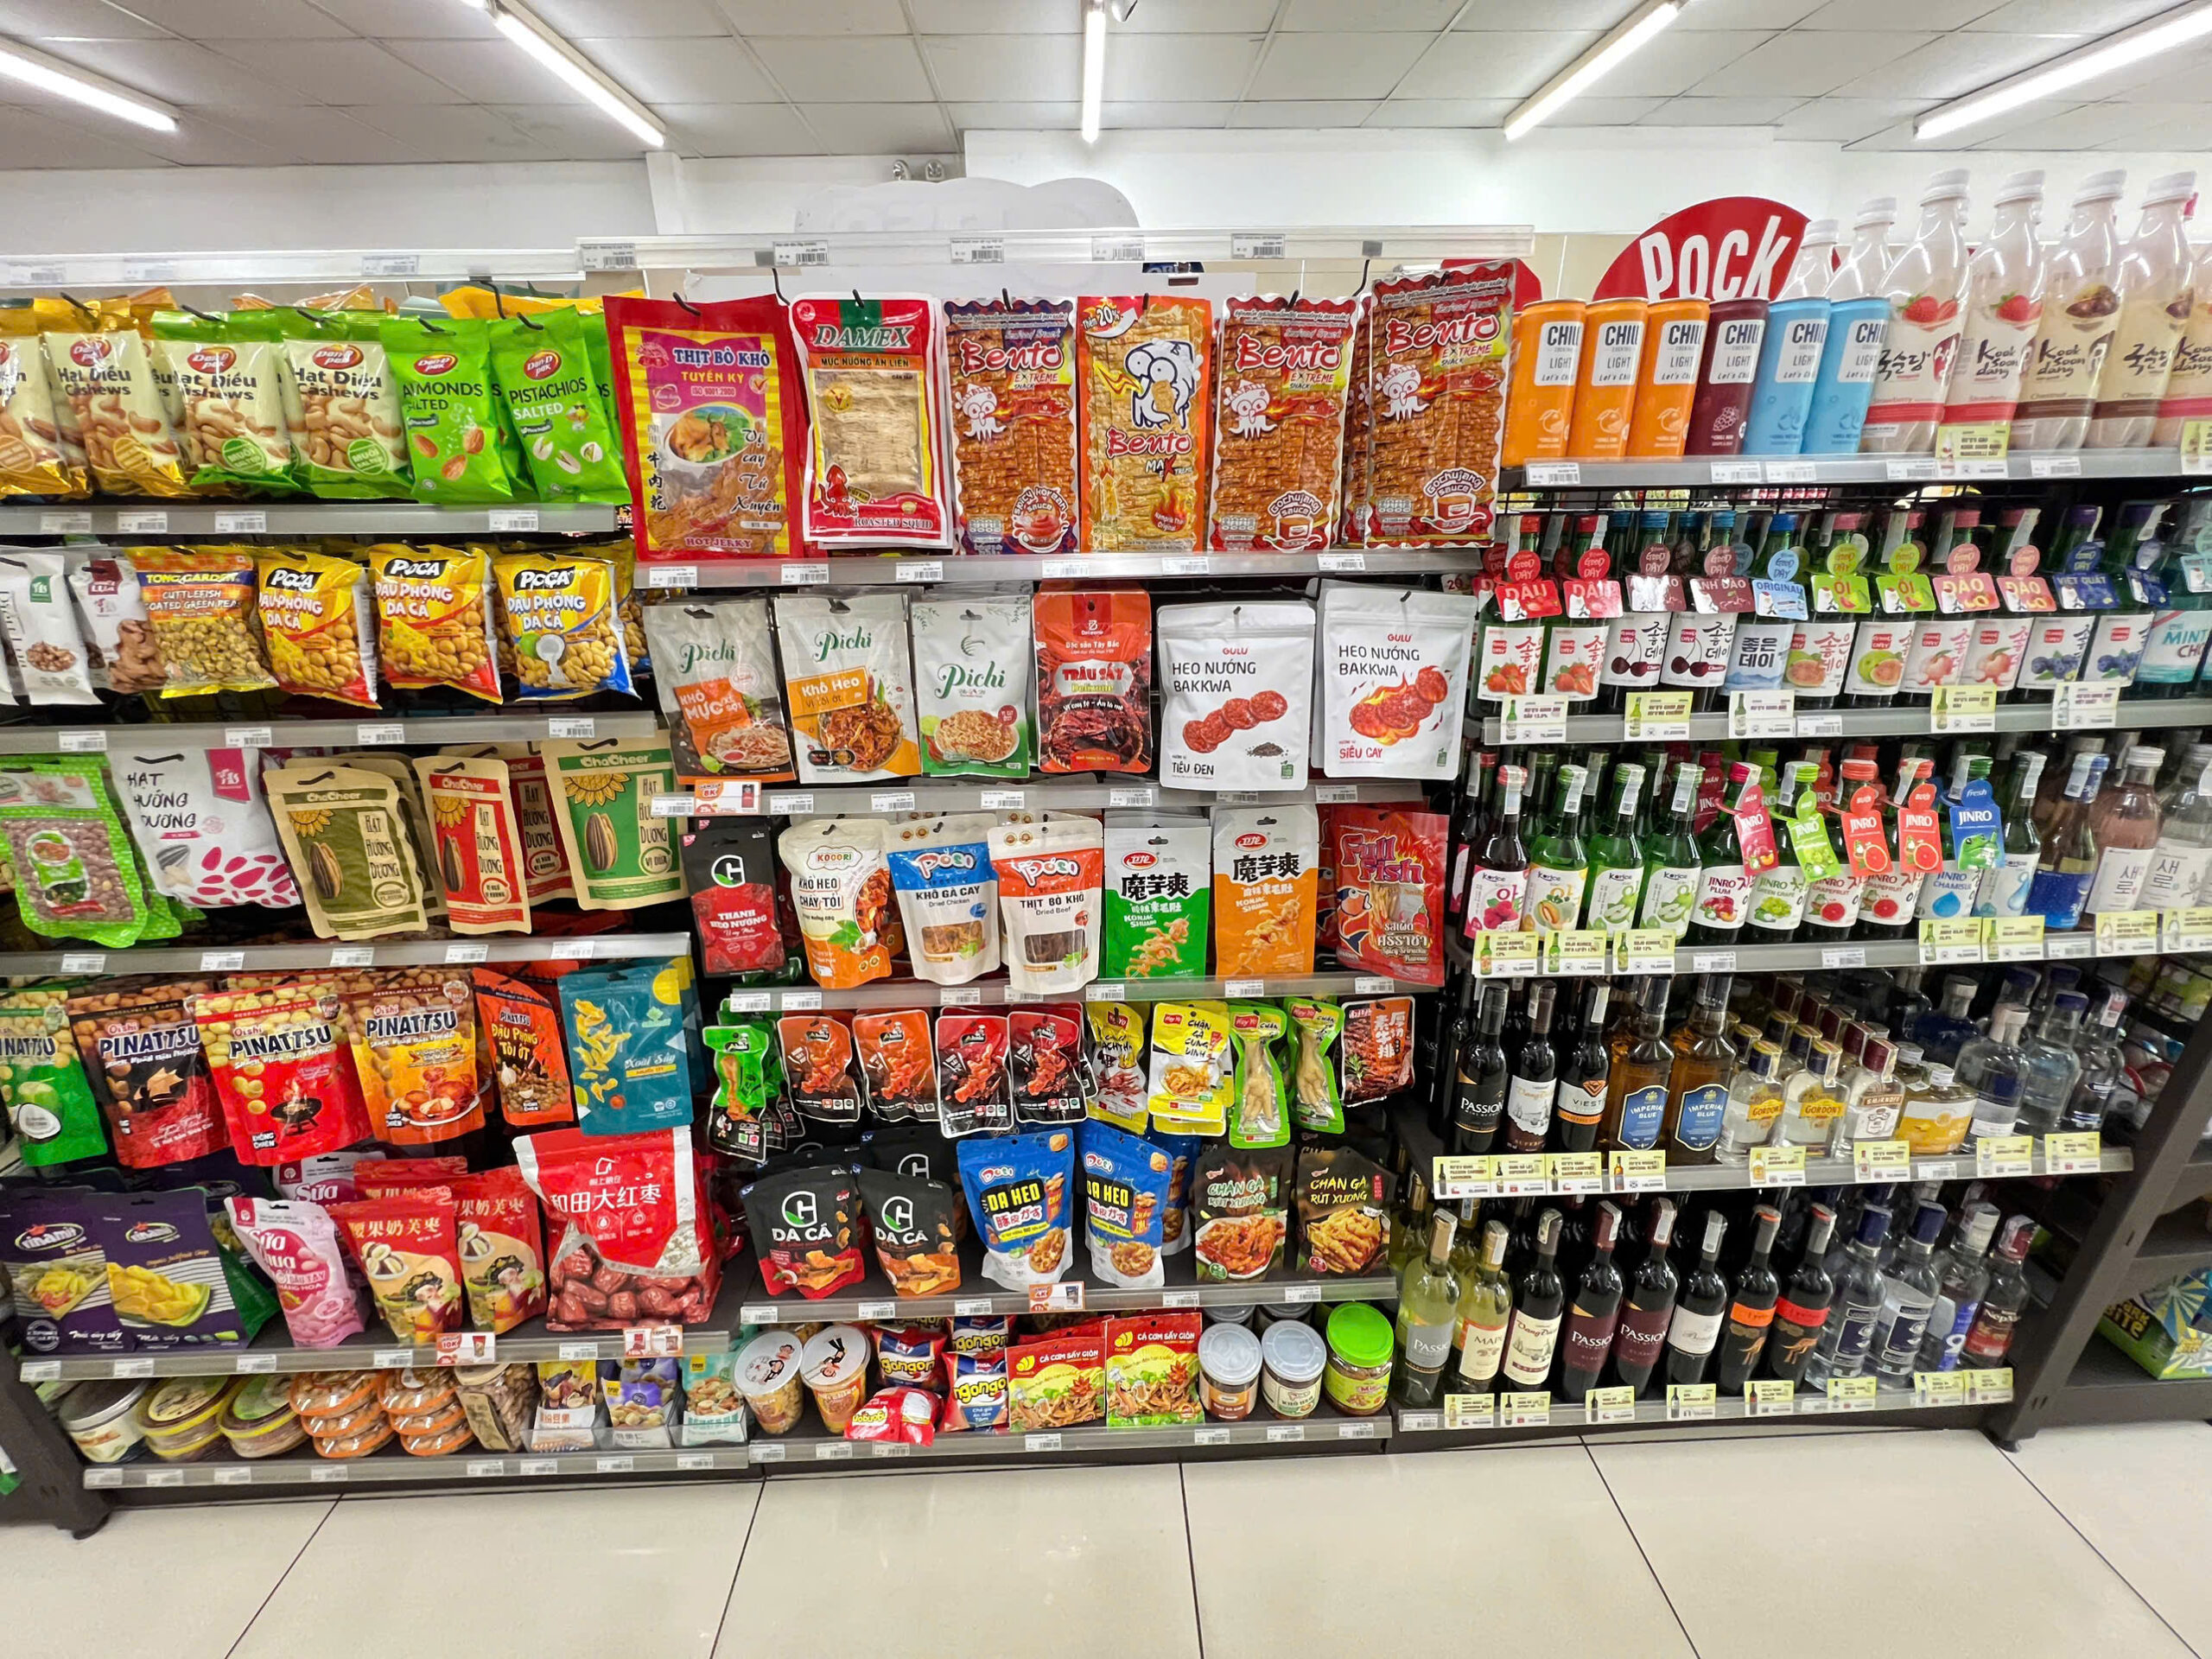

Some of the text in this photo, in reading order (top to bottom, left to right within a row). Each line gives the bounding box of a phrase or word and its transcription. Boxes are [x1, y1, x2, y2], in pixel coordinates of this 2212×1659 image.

[1096, 305, 1122, 327] 20%
[815, 324, 914, 347] DAMEX
[1385, 313, 1501, 357] Bento
[674, 347, 771, 368] THỊT BÒ KHÔ
[842, 355, 874, 366] NƯỚNG
[960, 340, 1064, 378] Bento
[1236, 334, 1342, 372] Bento
[1441, 345, 1492, 359] EXTREME
[1550, 356, 1573, 369] LIGHT
[1607, 357, 1631, 369] LIGHT
[1670, 356, 1694, 368] LIGHT
[1727, 355, 1751, 368] LIGHT
[1014, 372, 1058, 384] EXTREME
[1290, 372, 1335, 384] EXTREME
[509, 377, 588, 404] PISTACHIOS
[512, 402, 563, 421] SALTED
[1107, 427, 1193, 459] Bento
[1426, 469, 1485, 498] Gochujang
[1439, 484, 1469, 497] sauce
[1269, 493, 1323, 517] Gochujang
[1281, 505, 1309, 516] sauce
[855, 518, 933, 530] ROASTED SQUID
[685, 537, 752, 550] HOT JERKY
[390, 559, 442, 577] POCA
[1515, 569, 1534, 581] DAY
[1584, 569, 1603, 579] DAY
[162, 588, 222, 601] CUTTLEFISH
[399, 582, 454, 603] PHỘNG
[1503, 582, 1548, 601] DÂU
[183, 600, 215, 610] GREEN
[385, 599, 430, 618] DA CÁ
[533, 591, 587, 612] PHỘNG
[266, 613, 302, 630] DA CÁ
[523, 613, 563, 632] DA CÁ
[812, 626, 873, 663] Pichi
[1387, 633, 1413, 644] GULU
[1740, 636, 1777, 653] 좋은
[679, 639, 734, 674] Pichi
[1223, 647, 1249, 656] GULU
[1338, 644, 1421, 662] HEO NƯỚNG
[1173, 660, 1257, 676] HEO NƯỚNG
[1738, 652, 1775, 669] 데이
[1061, 665, 1097, 682] TRÂU
[1338, 662, 1399, 677] BAKKWA
[801, 677, 861, 698] Khô Heo
[934, 660, 1007, 700] Pichi
[1173, 679, 1232, 693] BAKKWA
[679, 690, 705, 707] KHÔ
[683, 701, 724, 721] MỰC
[580, 753, 650, 767] ChaCheer
[1365, 746, 1384, 760] CAY
[1172, 760, 1215, 777] TIÊU ĐEN
[1965, 788, 1987, 798] fresh
[1904, 814, 1933, 829] JINRO
[1958, 810, 1993, 825] JINRO
[1340, 832, 1397, 866] Full
[1232, 852, 1300, 884] 魔芋爽
[1358, 856, 1426, 884] Fish
[817, 877, 838, 889] HEO
[1121, 872, 1190, 903] 魔芋爽
[1707, 875, 1737, 889] JINRO
[916, 885, 981, 900] KHÔ GÀ CAY
[1709, 887, 1732, 896] PLUM
[928, 897, 971, 908] Dried Chicken
[1020, 893, 1085, 911] THỊT BÒ KHÔ
[1035, 905, 1071, 916] Dried Beef
[108, 1022, 139, 1035] Oishi
[365, 1009, 458, 1038] PINATTSU
[98, 1025, 204, 1058] PINATTSU
[228, 1024, 332, 1060] PINATTSU
[1460, 1096, 1503, 1114] PASSION
[1638, 1112, 1657, 1122] BLUE
[1011, 1182, 1040, 1206] HEO
[1103, 1185, 1129, 1207] HEO
[772, 1227, 801, 1243] DA
[1621, 1323, 1668, 1344] PASSION
